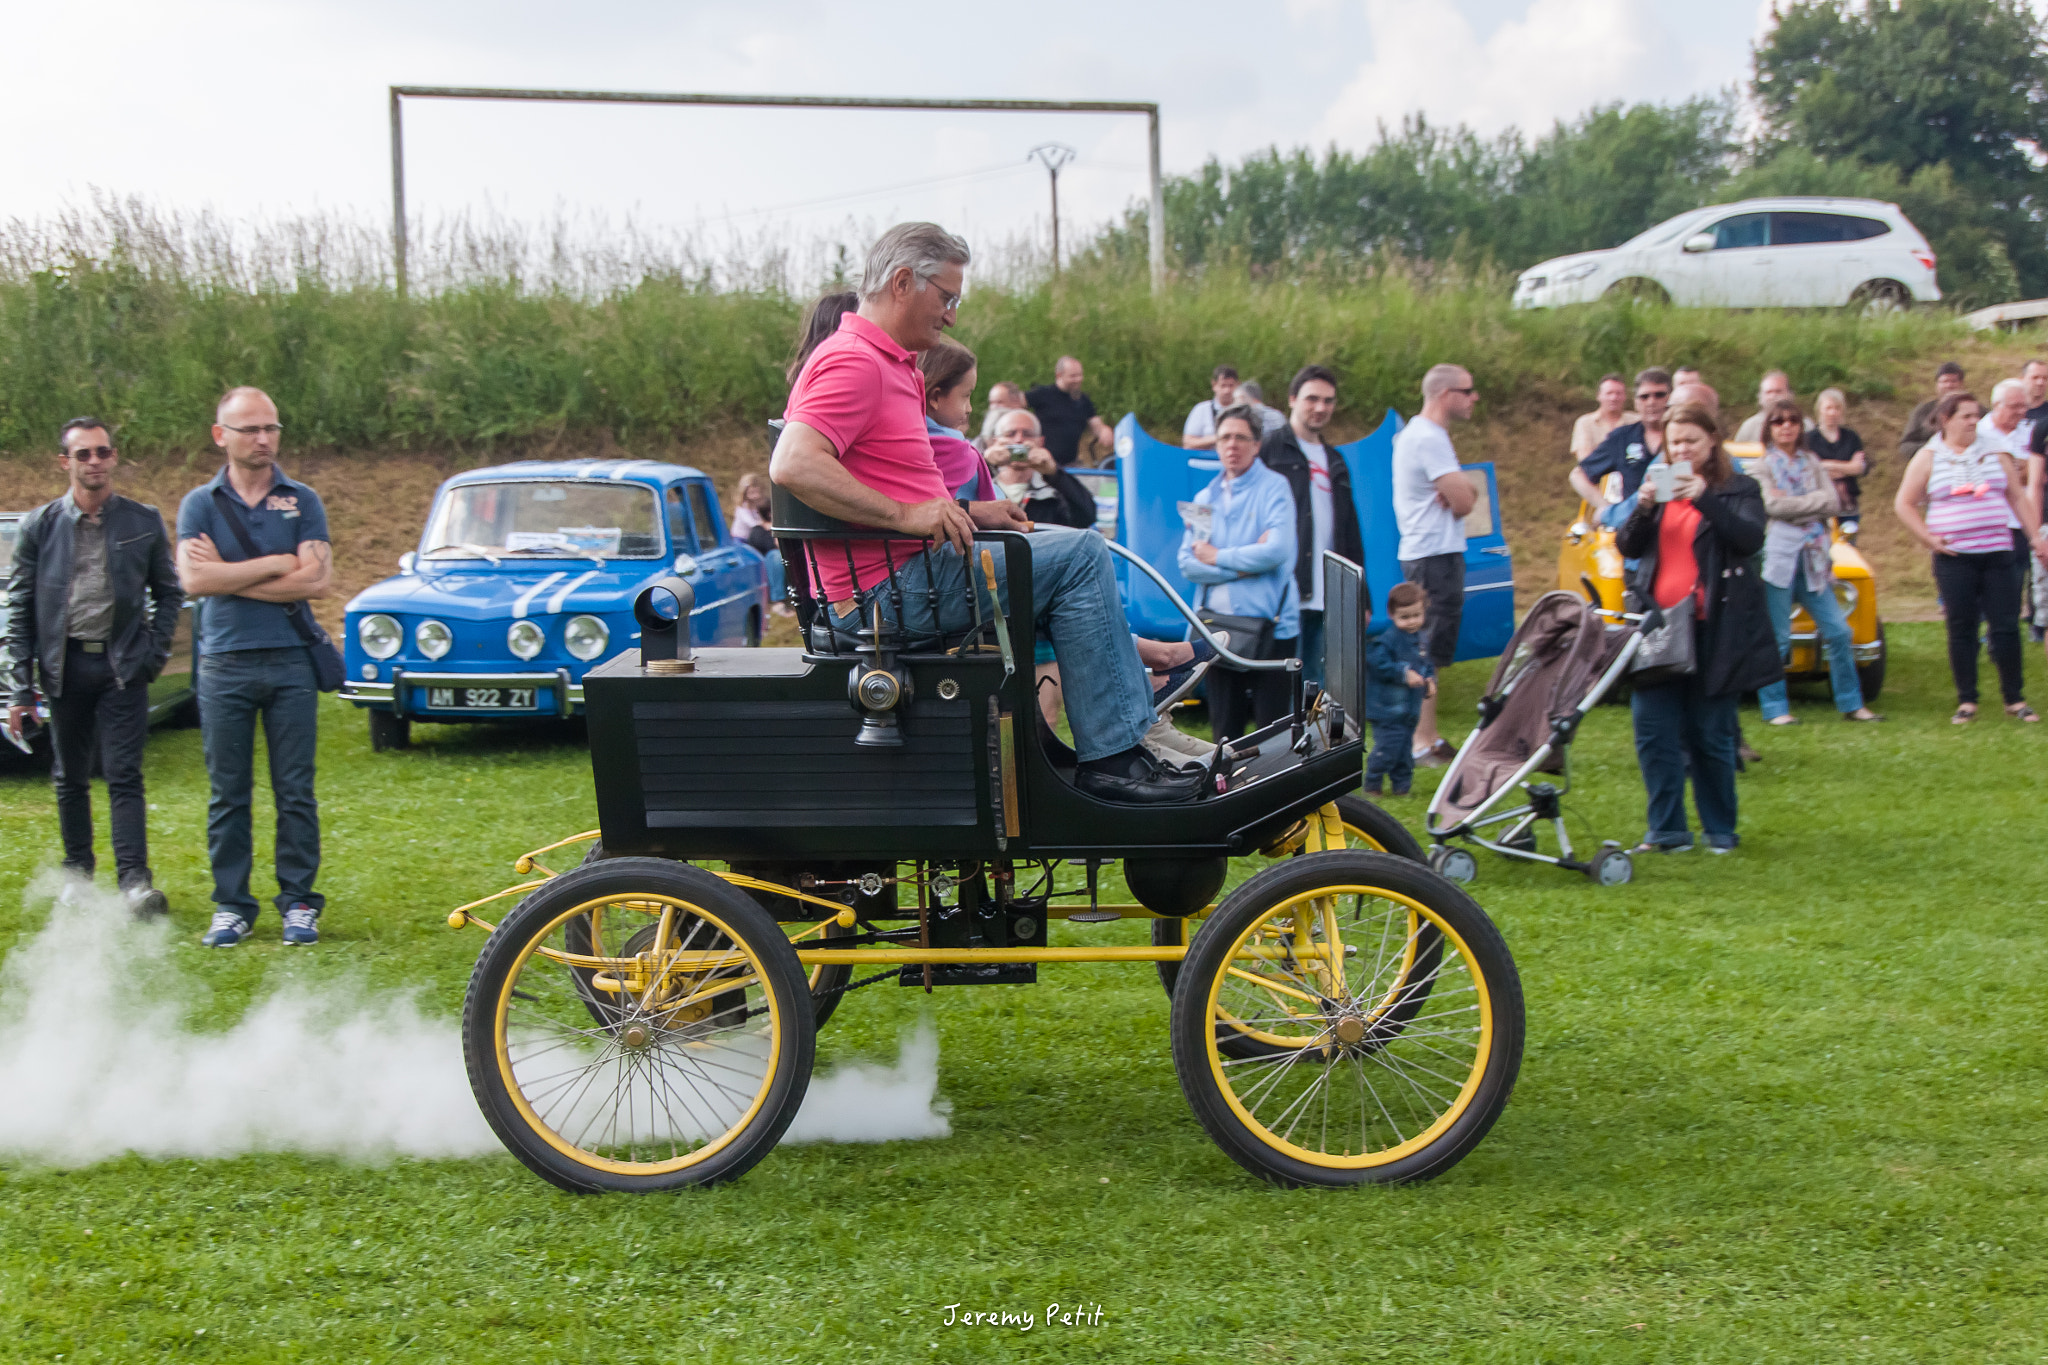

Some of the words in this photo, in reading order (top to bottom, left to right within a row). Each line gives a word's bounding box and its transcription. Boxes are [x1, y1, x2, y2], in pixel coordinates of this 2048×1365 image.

[431, 688, 455, 706] AM
[465, 688, 501, 707] 922
[508, 688, 533, 707] ZY
